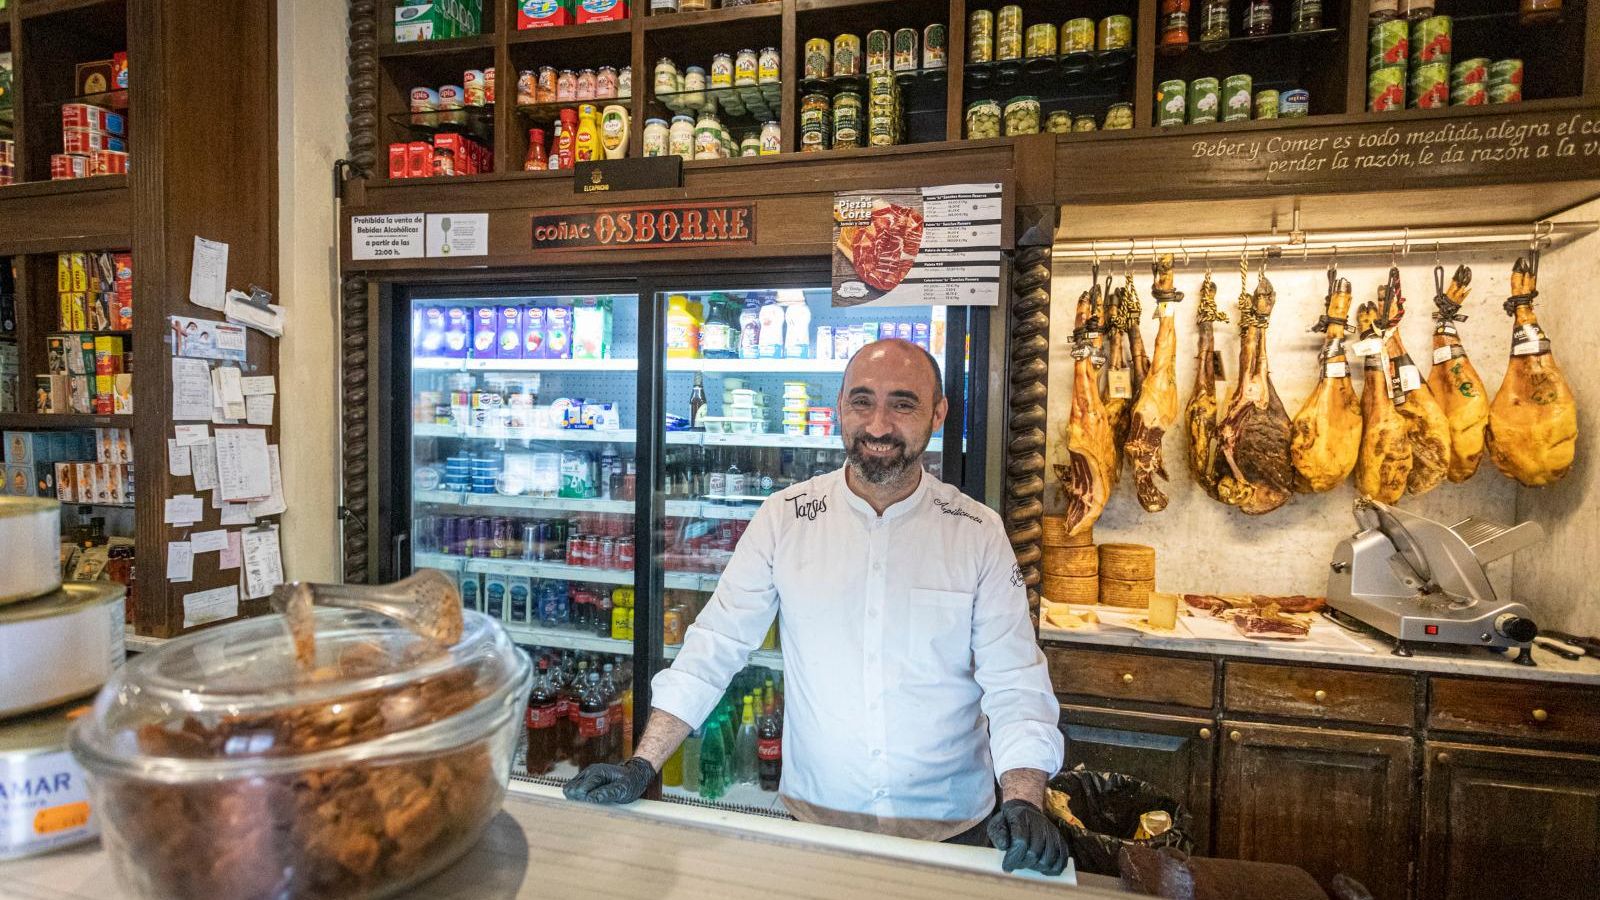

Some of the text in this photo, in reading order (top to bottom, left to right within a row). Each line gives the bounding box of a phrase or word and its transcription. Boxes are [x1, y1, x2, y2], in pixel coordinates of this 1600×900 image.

[1192, 138, 1245, 158] Beber
[1249, 141, 1261, 160] y
[1267, 136, 1329, 153] Comer
[1333, 136, 1352, 149] es
[1358, 127, 1400, 147] todo
[1556, 114, 1581, 136] el
[1267, 152, 1328, 175] perder
[1331, 150, 1350, 170] la
[1418, 145, 1434, 165] le
[1440, 143, 1465, 163] da
[1536, 145, 1550, 158] a
[1556, 137, 1577, 157] la
[839, 199, 872, 209] Piezas
[413, 216, 423, 224] de
[841, 209, 872, 219] Corte
[357, 226, 382, 234] Bebidas
[535, 208, 749, 244] COÑAC OSBORNE
[785, 493, 827, 521] Tarsus
